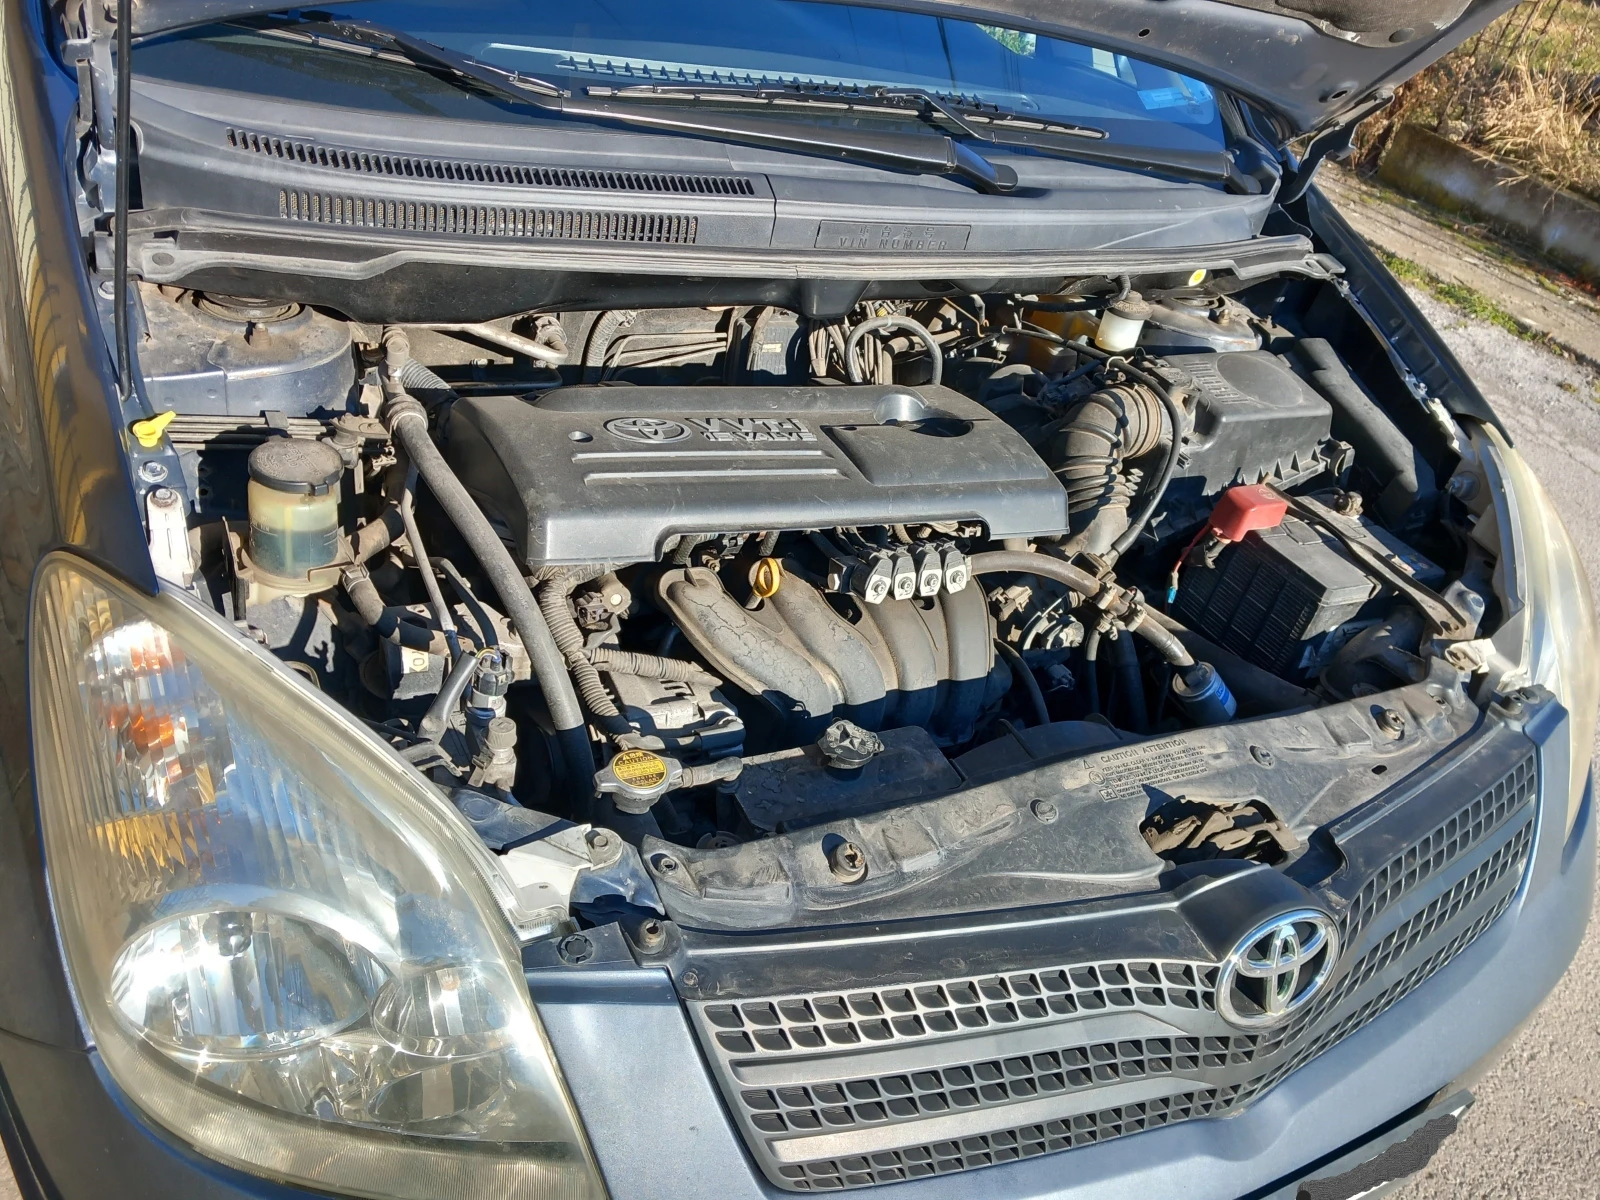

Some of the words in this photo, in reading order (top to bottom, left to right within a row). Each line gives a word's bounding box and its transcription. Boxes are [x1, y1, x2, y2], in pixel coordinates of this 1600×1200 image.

[839, 237, 867, 249] VIN
[878, 238, 947, 250] NUMBER
[1101, 749, 1139, 763] CAUTION
[1142, 738, 1187, 757] ATTENTION
[618, 755, 653, 765] CAUTION
